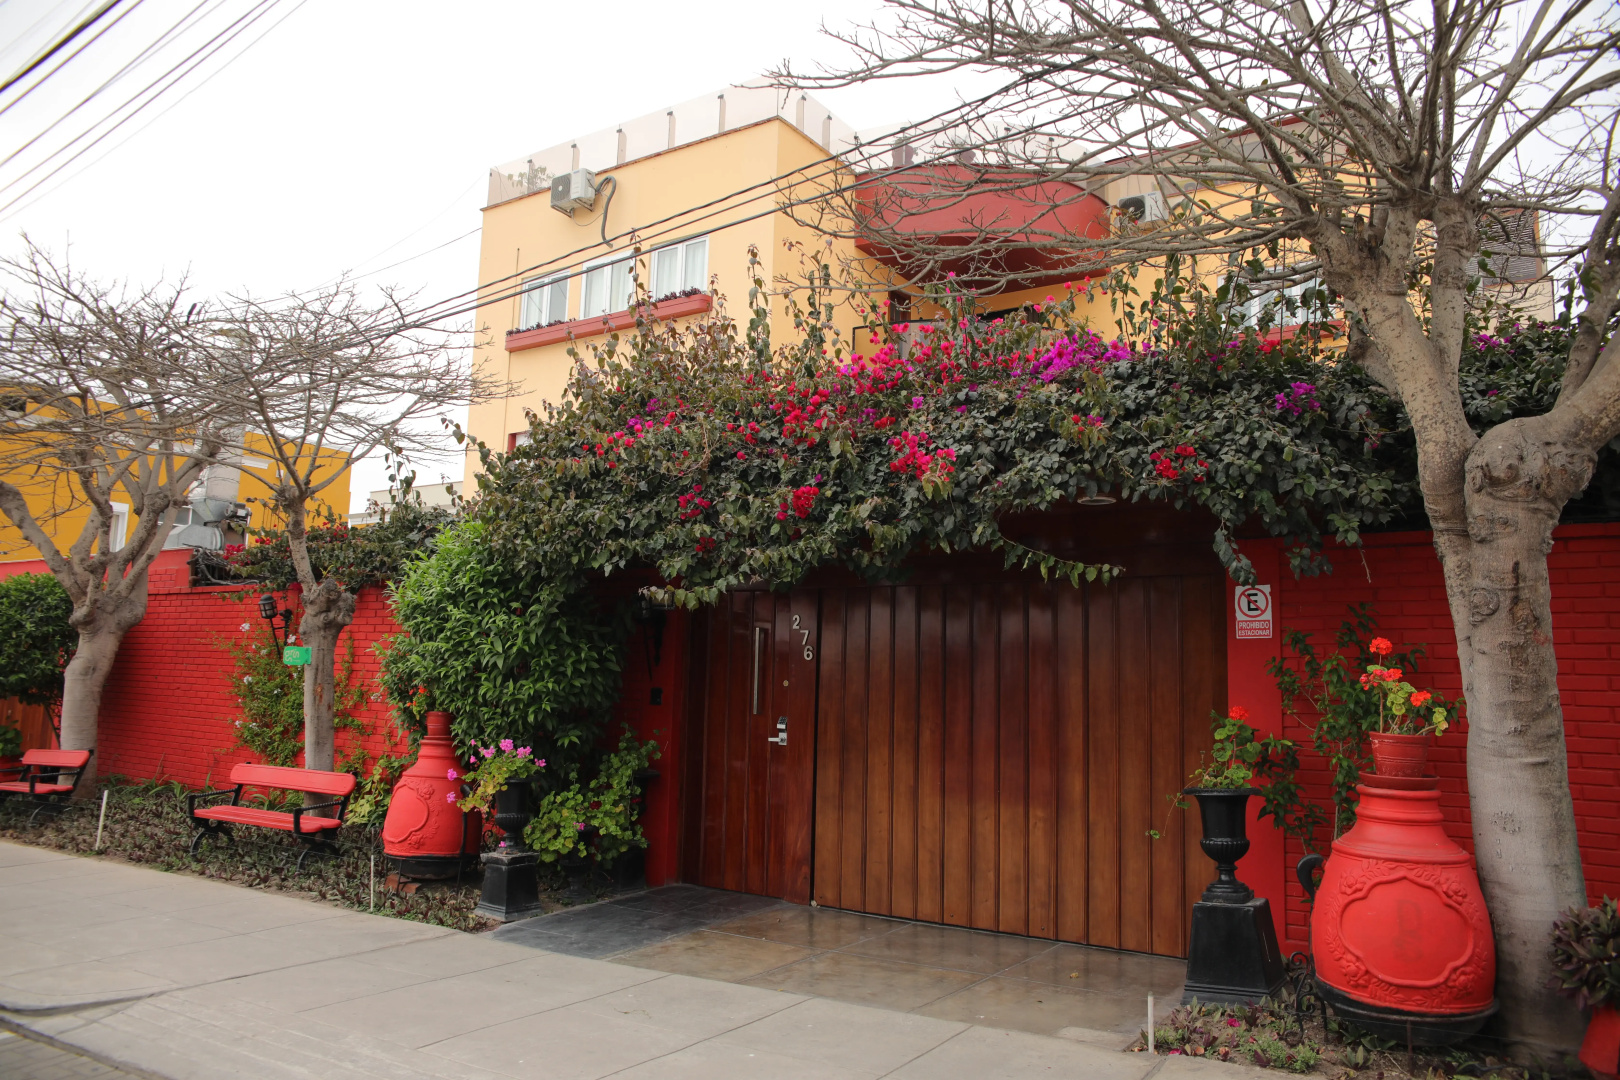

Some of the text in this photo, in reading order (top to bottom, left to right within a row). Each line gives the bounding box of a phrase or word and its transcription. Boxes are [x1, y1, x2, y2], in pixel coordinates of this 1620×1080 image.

[1247, 593, 1260, 611] E
[1239, 621, 1269, 629] PROHIBIDO
[793, 614, 813, 660] 276
